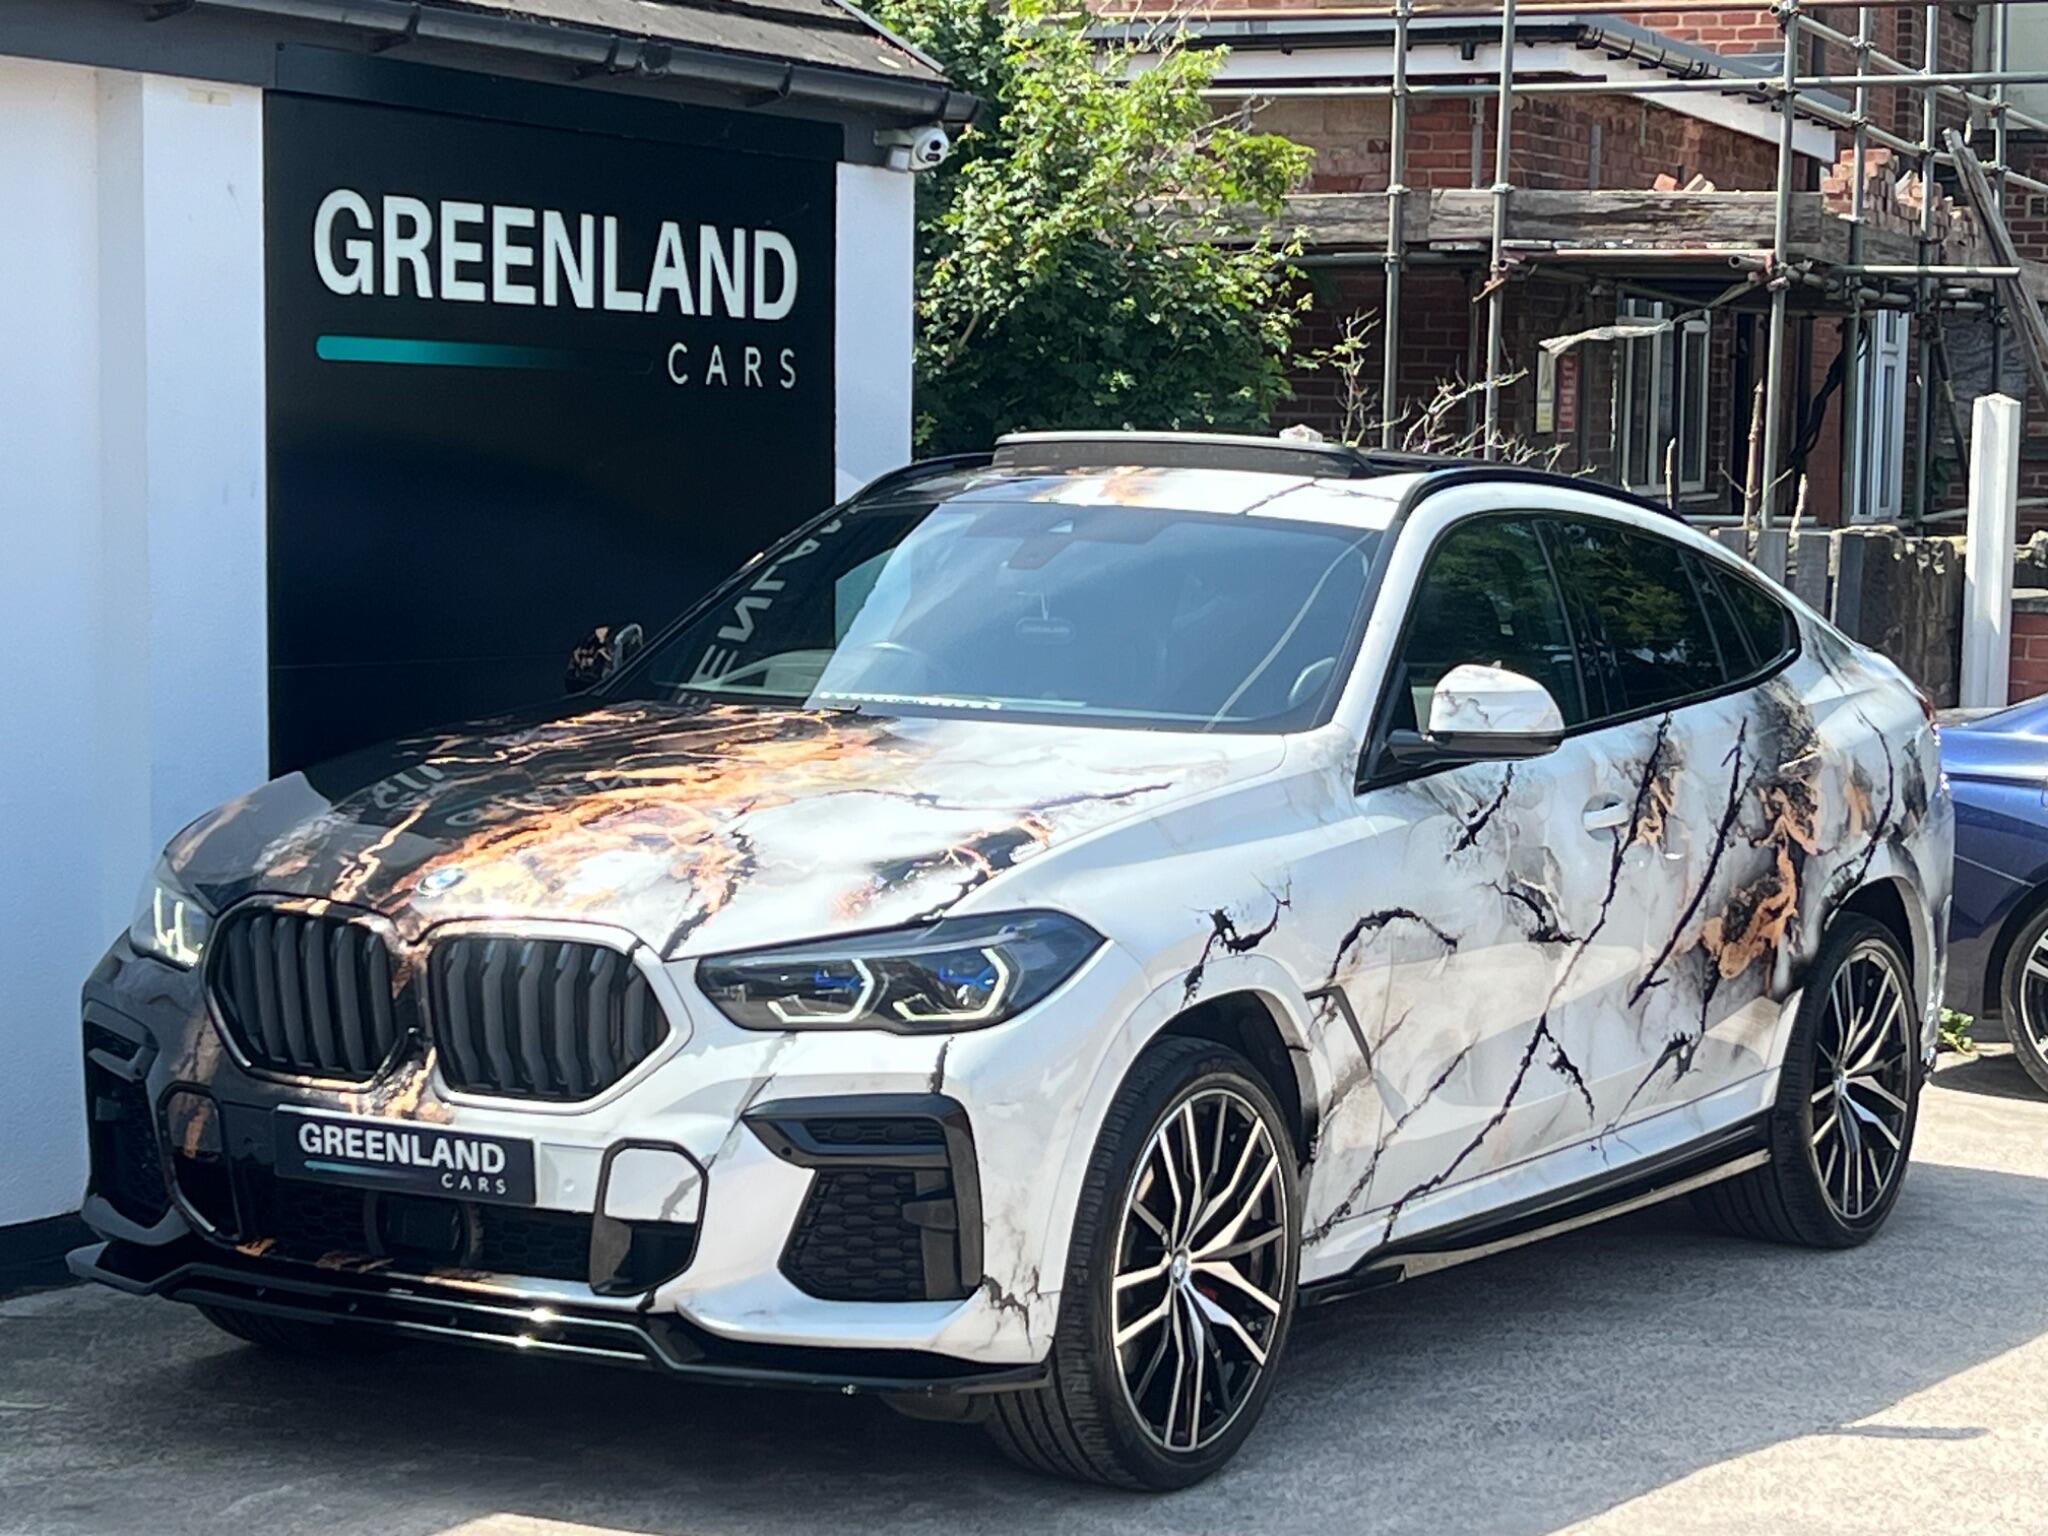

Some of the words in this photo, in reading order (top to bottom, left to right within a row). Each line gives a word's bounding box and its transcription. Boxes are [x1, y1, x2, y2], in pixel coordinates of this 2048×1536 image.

[313, 188, 799, 321] GREENLAND
[667, 342, 797, 389] CARS
[299, 1122, 506, 1174] GREENLAND
[441, 1172, 507, 1195] CARS
